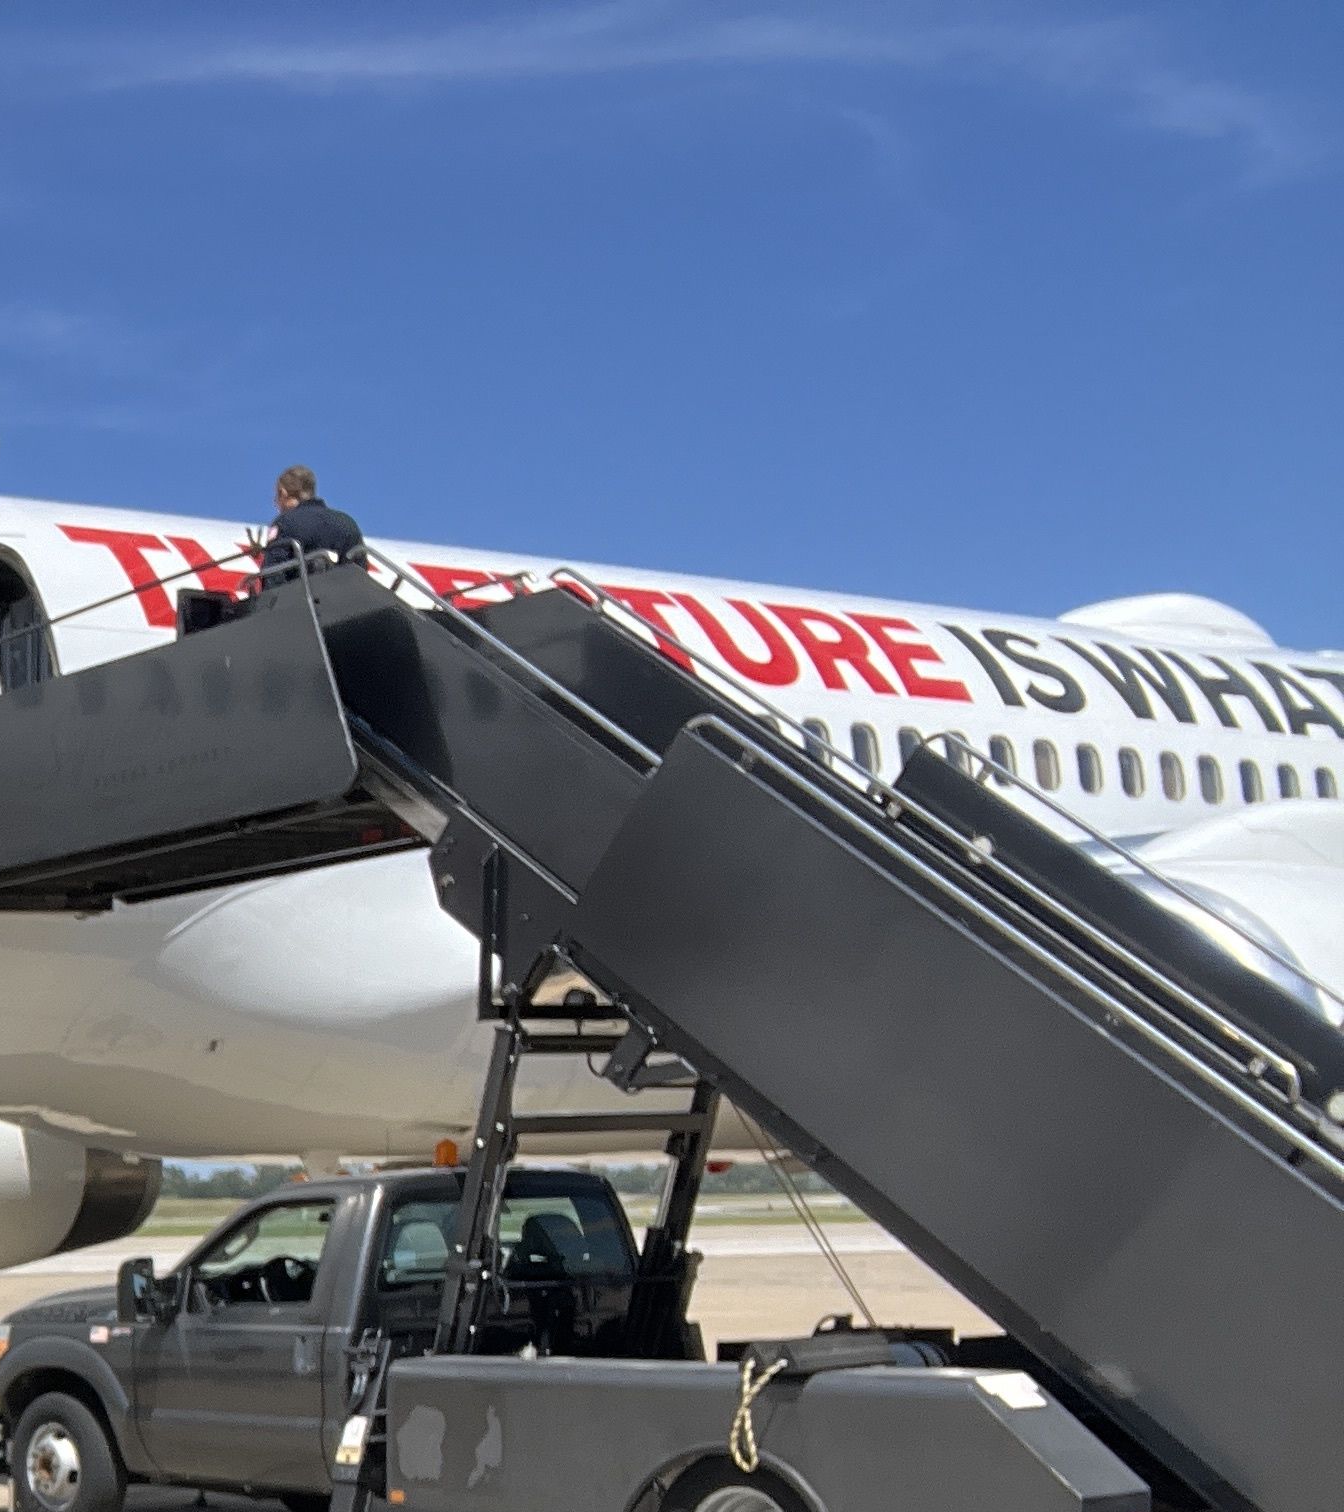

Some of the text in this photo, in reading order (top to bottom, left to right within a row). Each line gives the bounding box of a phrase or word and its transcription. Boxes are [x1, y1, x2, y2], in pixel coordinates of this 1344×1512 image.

[55, 524, 380, 629] TH
[408, 562, 973, 702] FTURE
[939, 622, 1086, 713] IS
